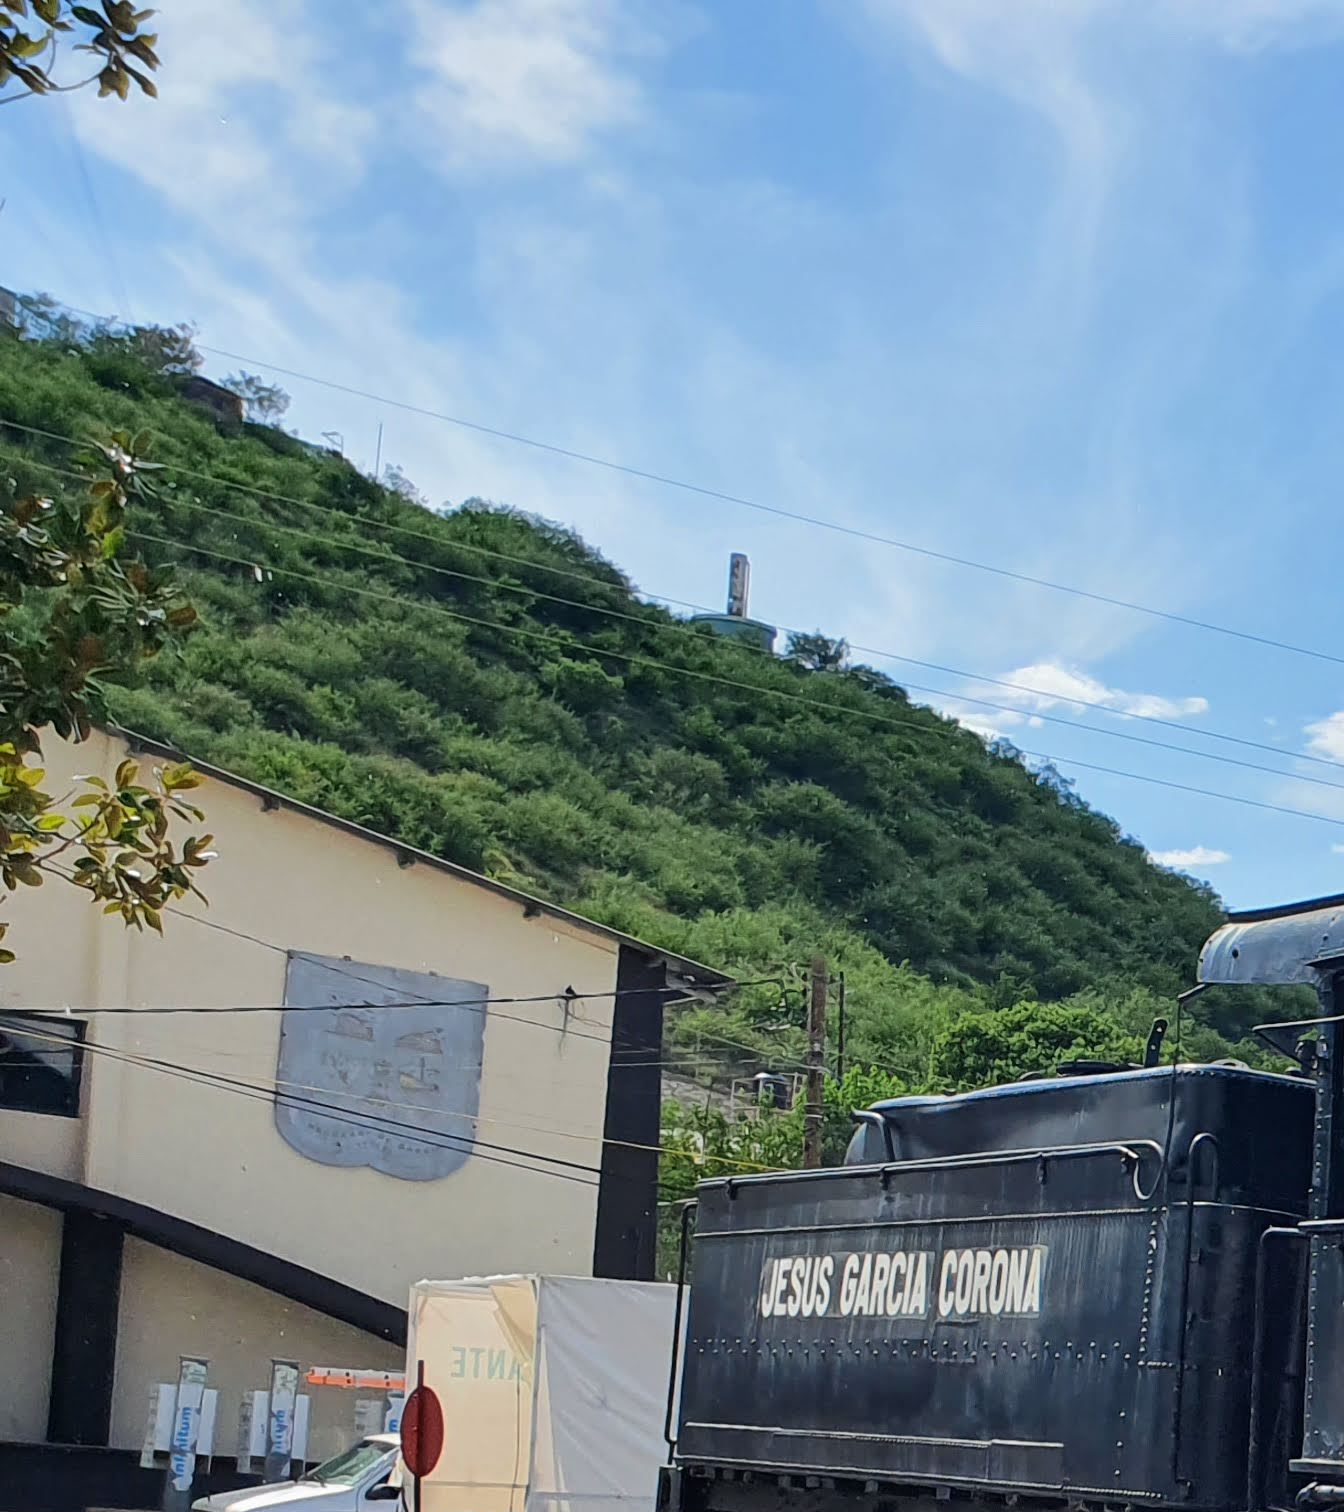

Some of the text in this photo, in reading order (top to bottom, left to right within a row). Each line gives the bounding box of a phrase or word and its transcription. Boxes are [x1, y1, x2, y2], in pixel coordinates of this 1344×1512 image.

[761, 1249, 1041, 1318] JESUS GARCIA CORONA
